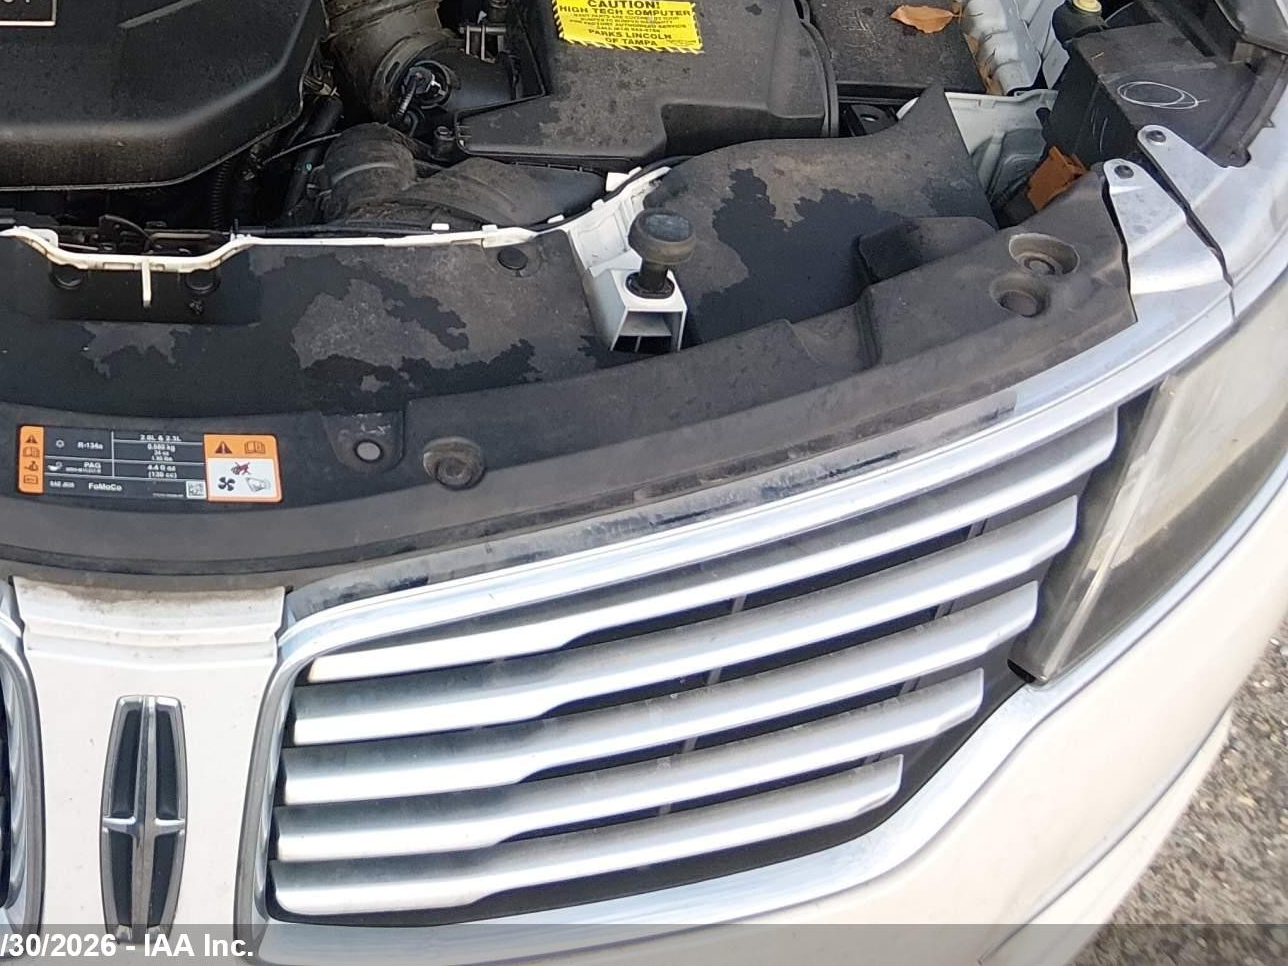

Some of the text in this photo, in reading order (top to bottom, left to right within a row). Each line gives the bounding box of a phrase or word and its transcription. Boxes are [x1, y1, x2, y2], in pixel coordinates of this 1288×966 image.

[588, 0, 660, 9] CAUTION!
[559, 5, 588, 13] HIGH
[626, 9, 691, 17] COMPUTER
[588, 29, 623, 37] PARKS
[626, 31, 672, 40] LINCOLN
[622, 38, 658, 46] TAMPA
[77, 441, 104, 450] R-134a
[88, 482, 123, 492] FoMoCo
